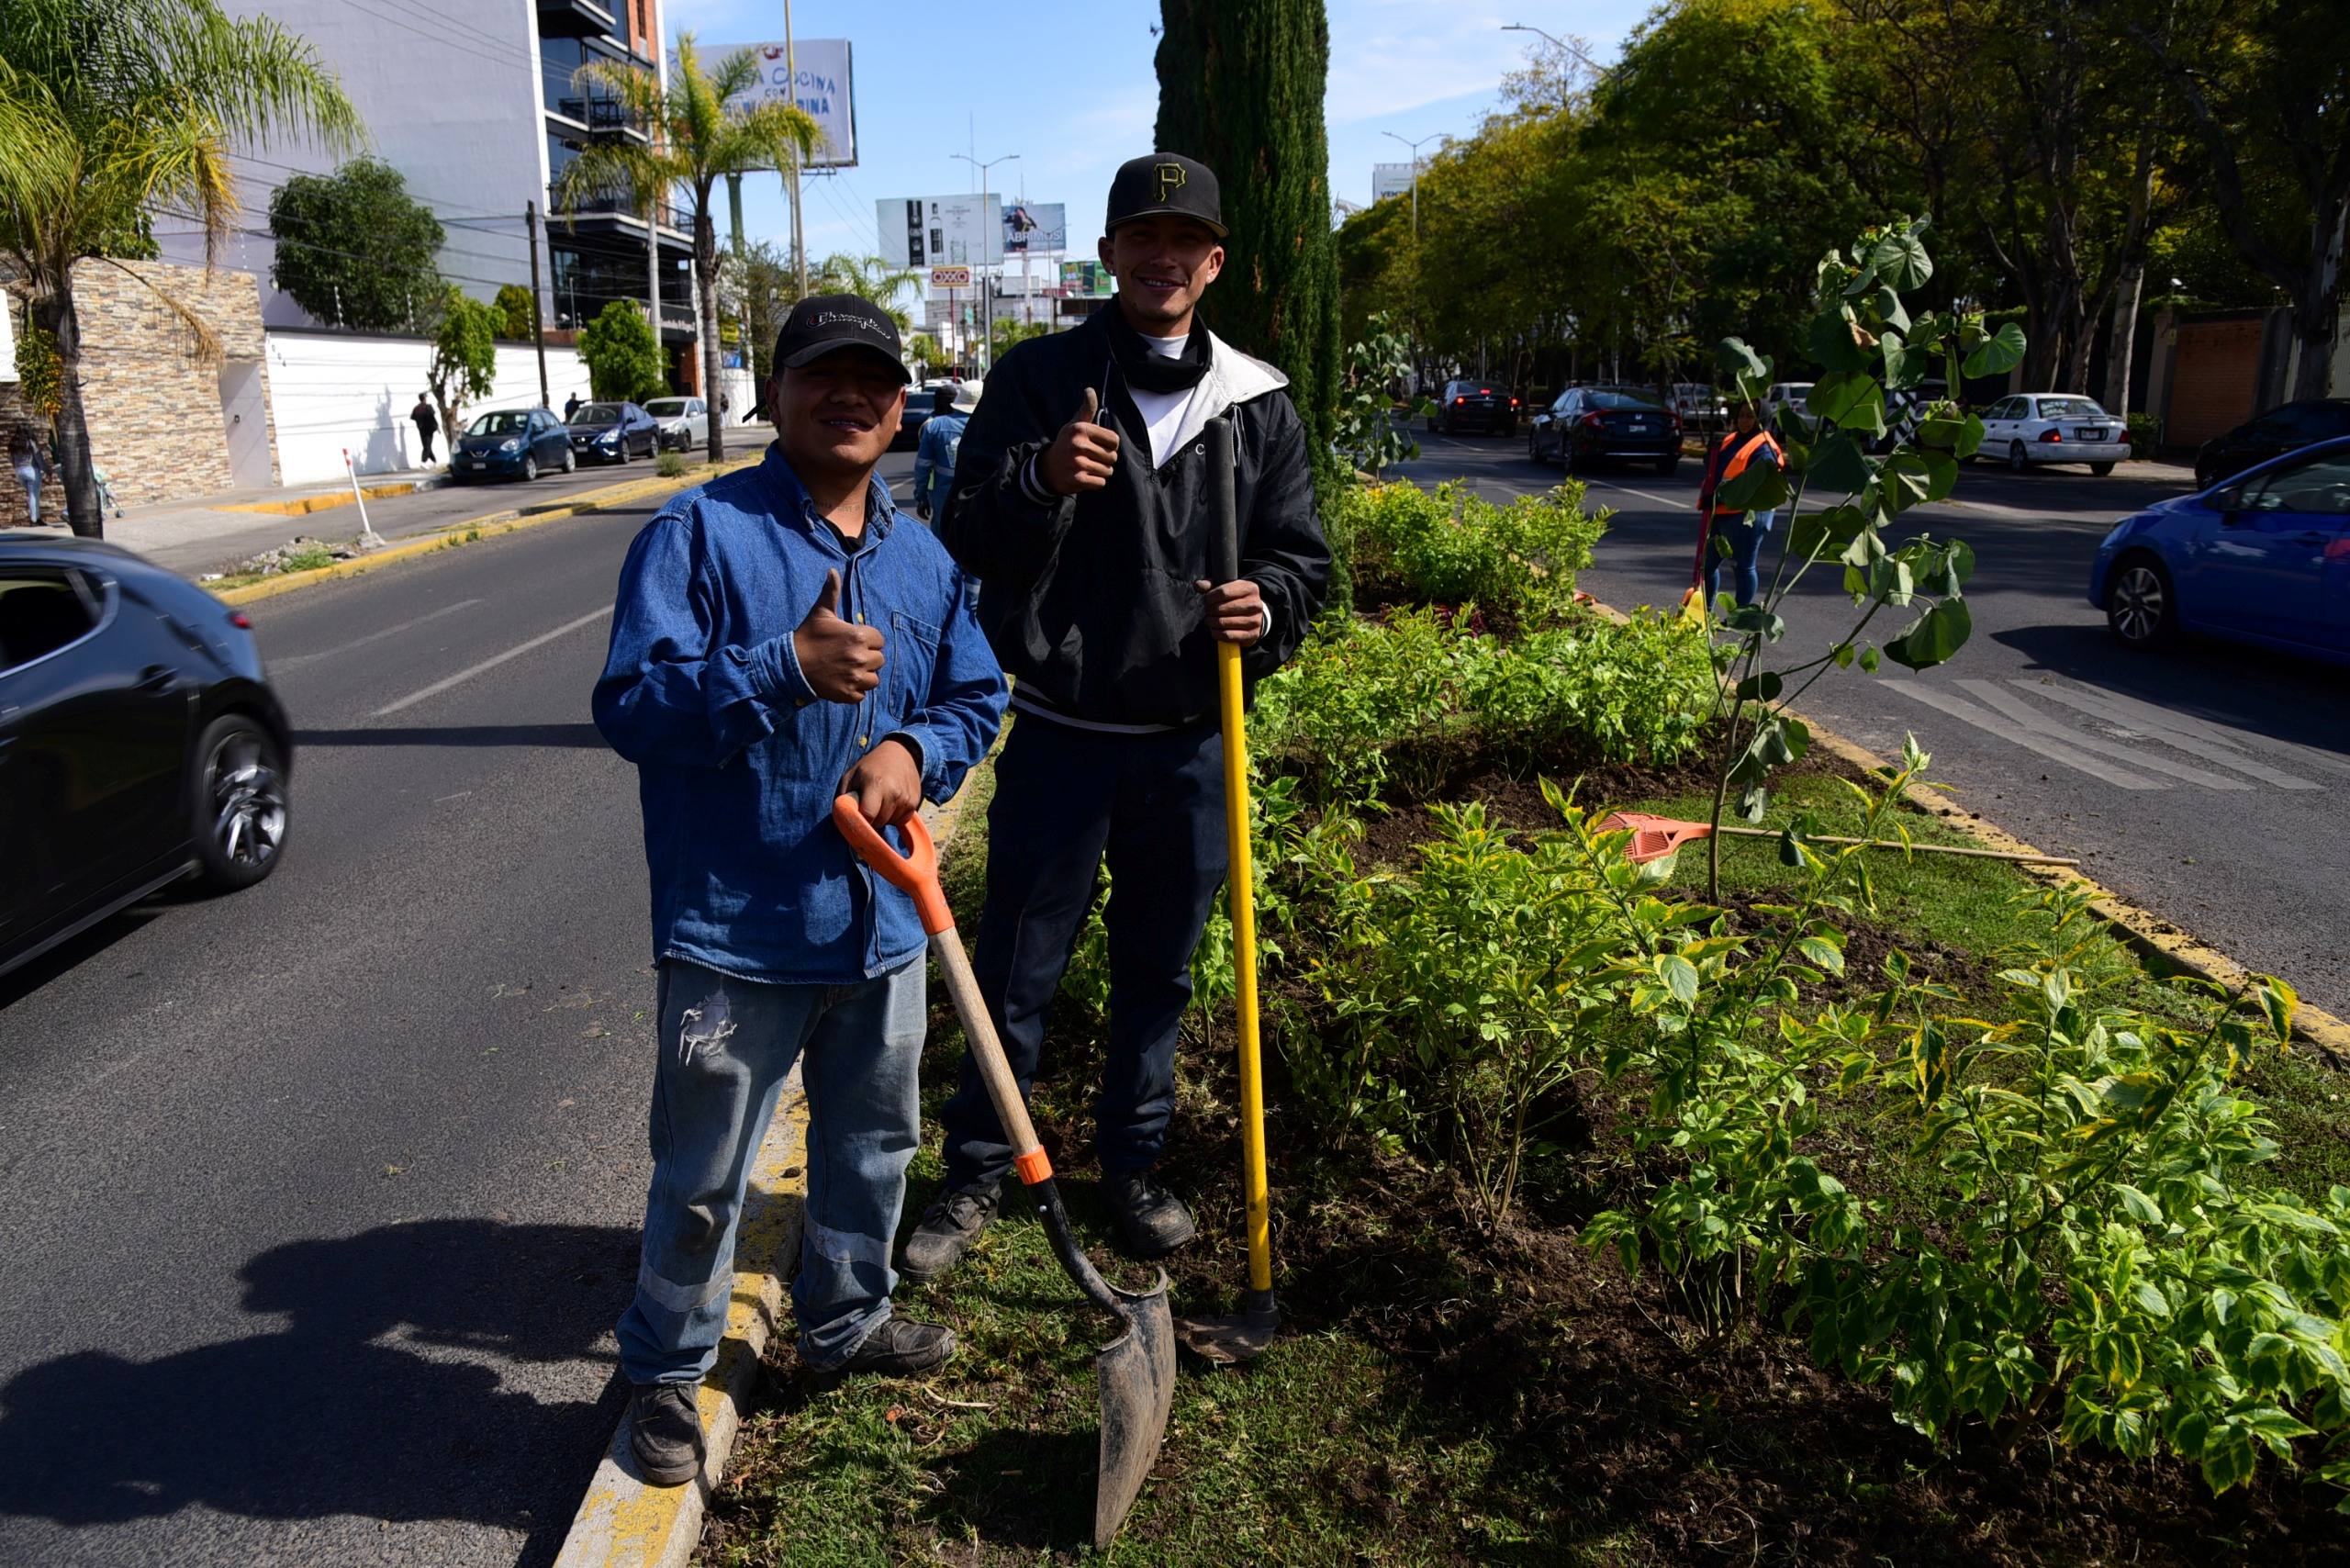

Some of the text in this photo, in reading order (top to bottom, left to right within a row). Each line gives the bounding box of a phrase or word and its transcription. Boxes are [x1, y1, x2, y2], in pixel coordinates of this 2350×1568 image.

[765, 86, 787, 97] CON
[1153, 162, 1187, 203] P
[1006, 230, 1064, 243] ABRIMOS!
[933, 271, 968, 284] OXXO
[806, 310, 891, 340] Champion
